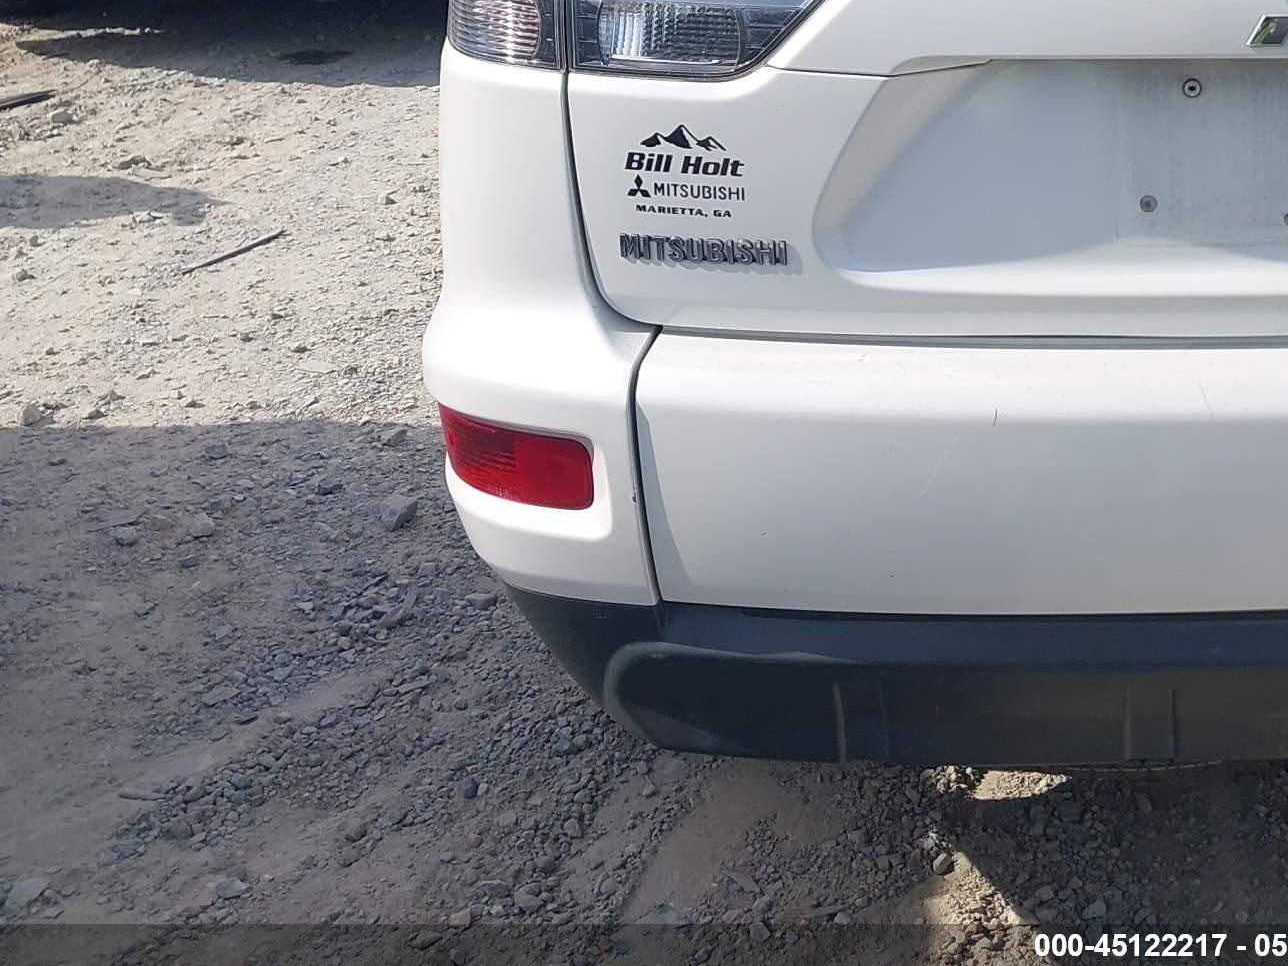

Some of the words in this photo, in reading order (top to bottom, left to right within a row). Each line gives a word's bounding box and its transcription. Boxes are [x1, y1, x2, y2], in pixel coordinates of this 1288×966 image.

[624, 151, 673, 173] Bill
[681, 155, 745, 177] Holt
[653, 182, 746, 201] MITSUBISHI
[635, 204, 709, 217] MARIETTA,
[713, 209, 732, 218] GA
[619, 233, 788, 266] MITSUBISHI
